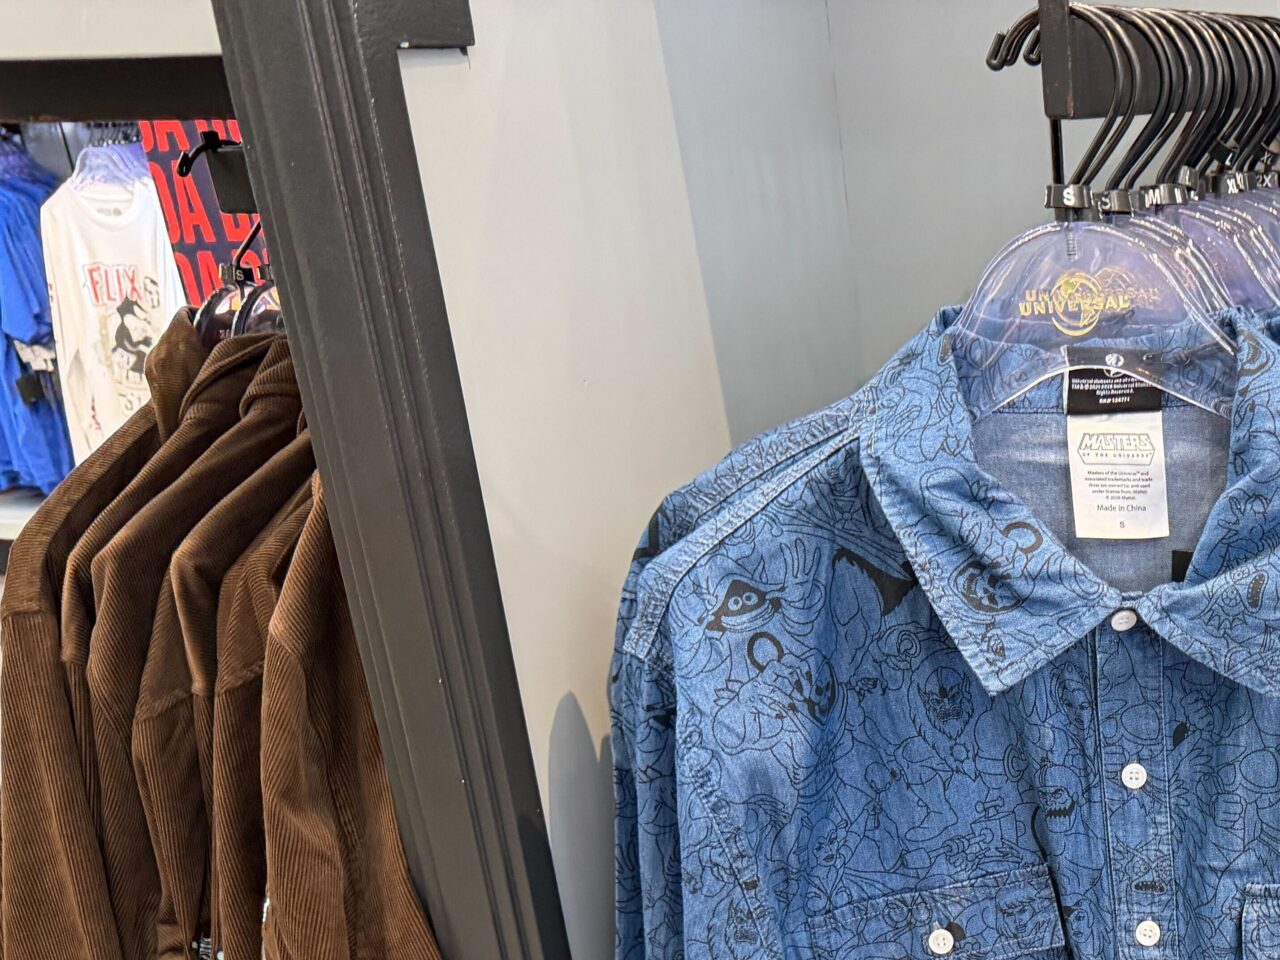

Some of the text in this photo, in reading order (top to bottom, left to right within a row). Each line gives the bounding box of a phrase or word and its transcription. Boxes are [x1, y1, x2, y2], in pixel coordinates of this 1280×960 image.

[1063, 186, 1075, 206] S
[87, 265, 143, 304] FLIX
[236, 270, 245, 280] S
[1019, 294, 1131, 316] UNIVERSAL
[1080, 433, 1154, 451] MASTERS
